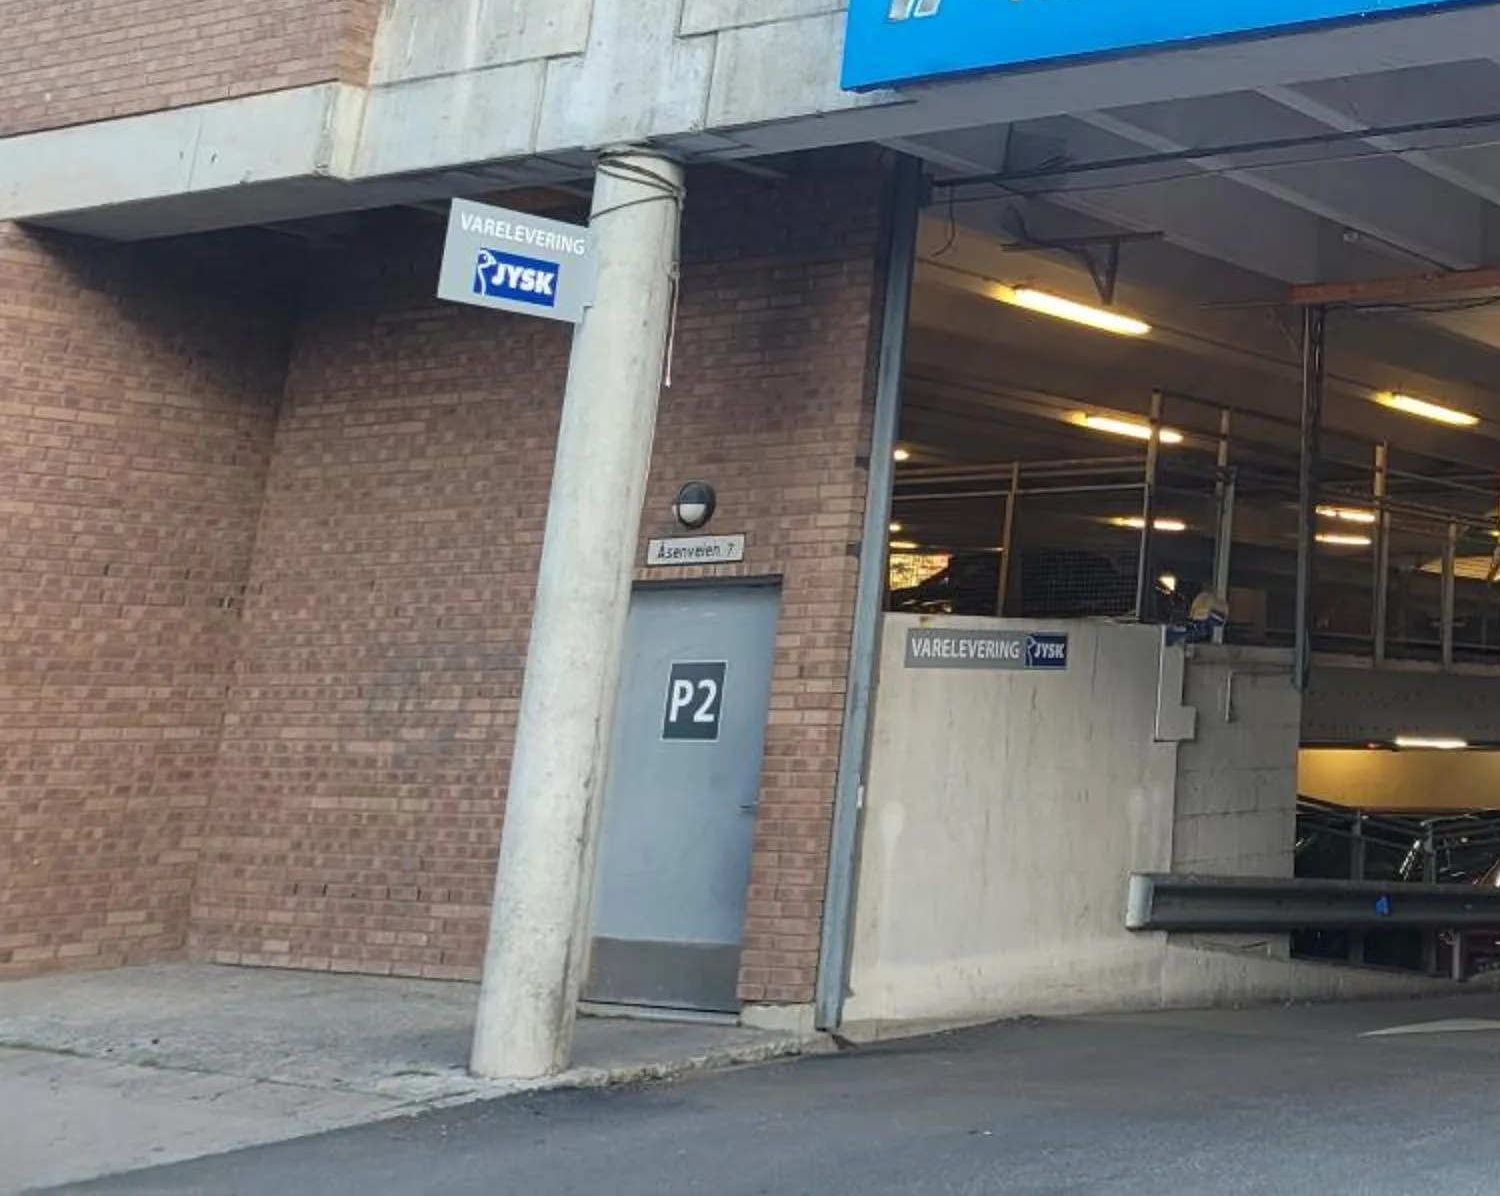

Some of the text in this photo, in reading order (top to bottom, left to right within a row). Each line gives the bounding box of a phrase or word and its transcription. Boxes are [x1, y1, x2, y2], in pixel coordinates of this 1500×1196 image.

[461, 212, 585, 254] VARELEVERING
[491, 263, 555, 295] JYSK
[657, 539, 735, 559] Åsenveien 7
[911, 637, 1020, 659] VARELEVERING
[1034, 641, 1065, 659] JYSK
[668, 678, 718, 723] P2
